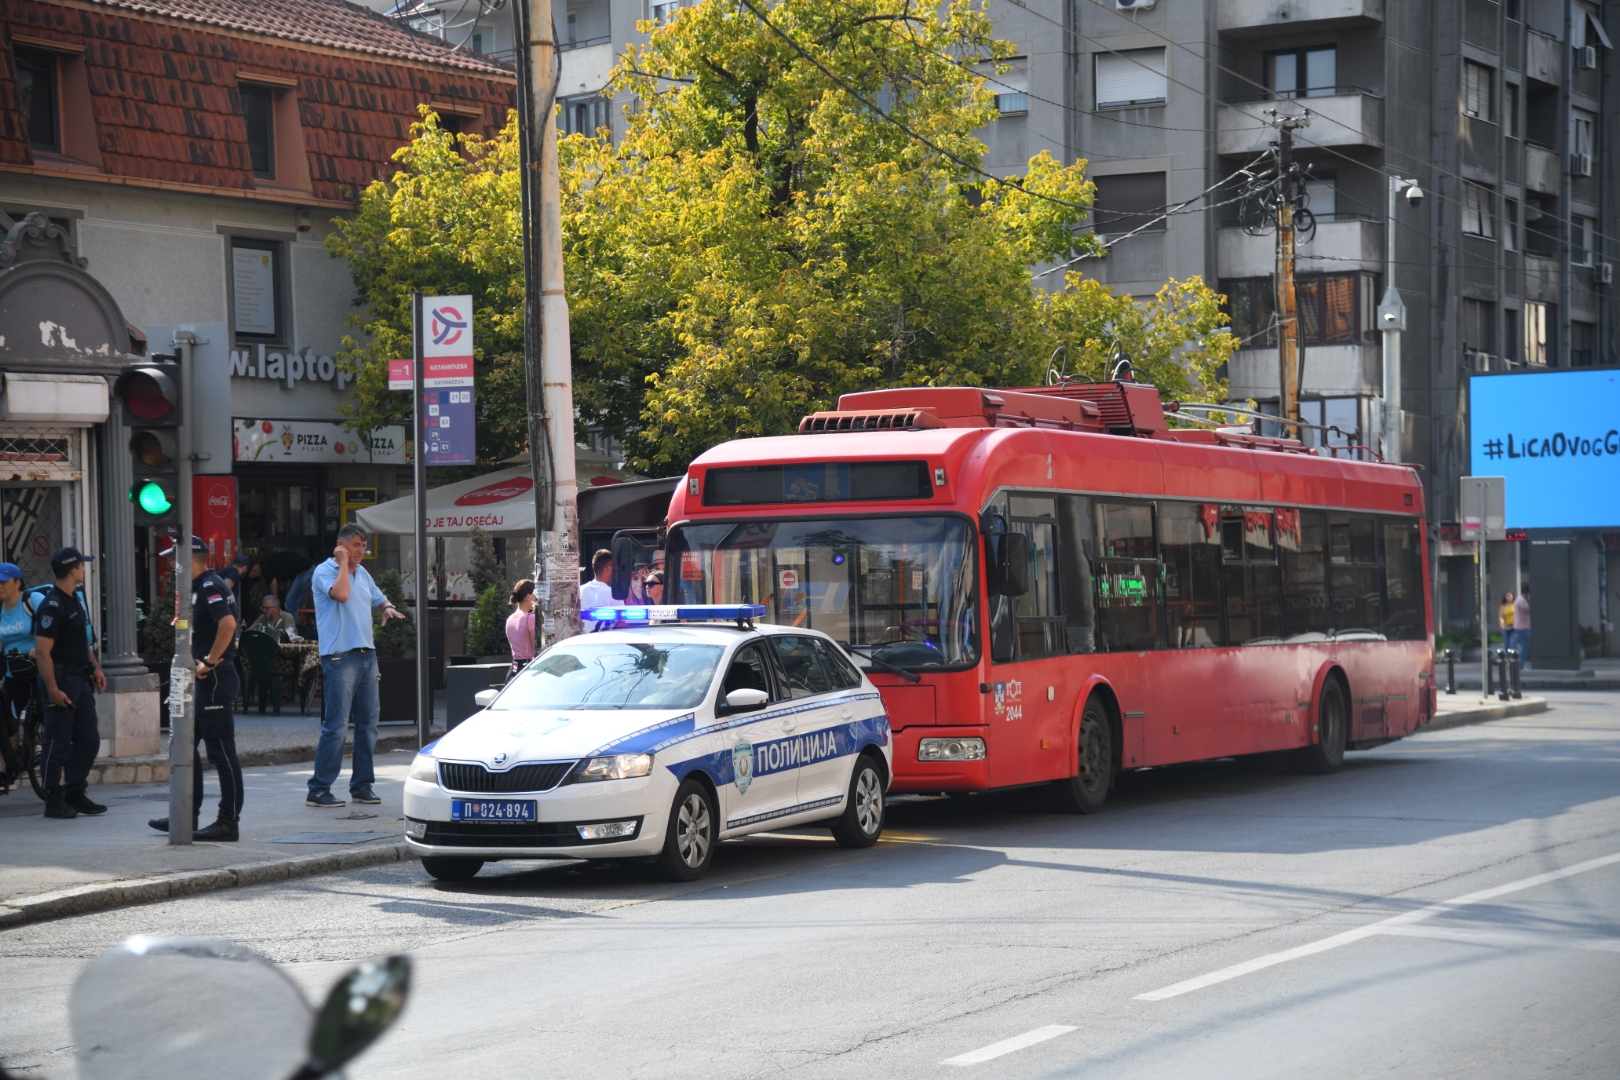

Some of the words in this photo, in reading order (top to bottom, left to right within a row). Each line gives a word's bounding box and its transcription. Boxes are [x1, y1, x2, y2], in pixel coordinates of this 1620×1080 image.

[229, 344, 362, 389] w.laptop
[403, 364, 410, 376] 1
[430, 363, 468, 371] КАТАНИЋЕВА
[297, 434, 328, 446] PIZZA
[370, 438, 395, 449] IZZA
[433, 517, 445, 527] JE
[446, 516, 463, 527] TAJ
[465, 514, 504, 526] OSEĆAJ
[648, 610, 677, 618] ПОЛИЦИЈА
[1006, 704, 1023, 722] 2044
[757, 730, 837, 773] ПОЛИЦИЈА
